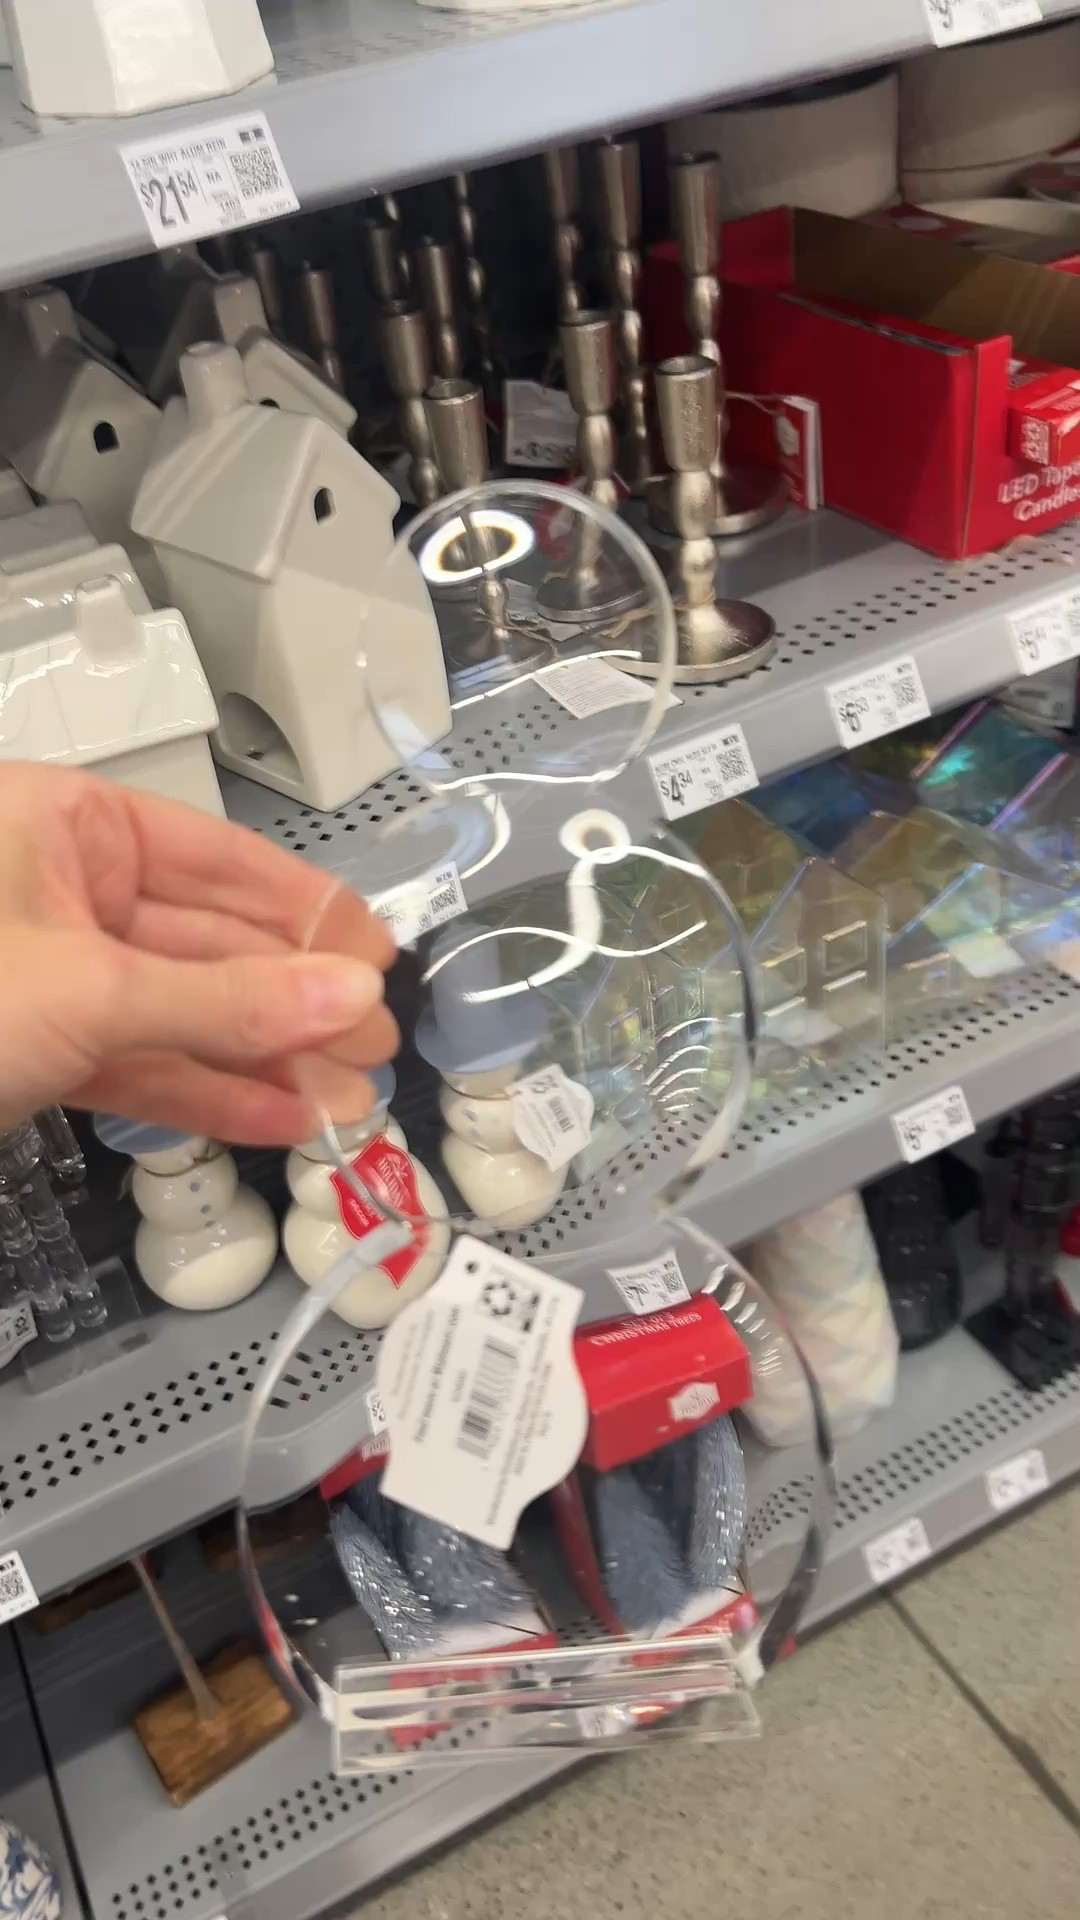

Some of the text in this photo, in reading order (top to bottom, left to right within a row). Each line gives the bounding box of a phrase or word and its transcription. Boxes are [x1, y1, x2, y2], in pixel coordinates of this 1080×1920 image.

[997, 473, 1040, 504] LED
[590, 1311, 703, 1346] CHRISTMAS TREES
